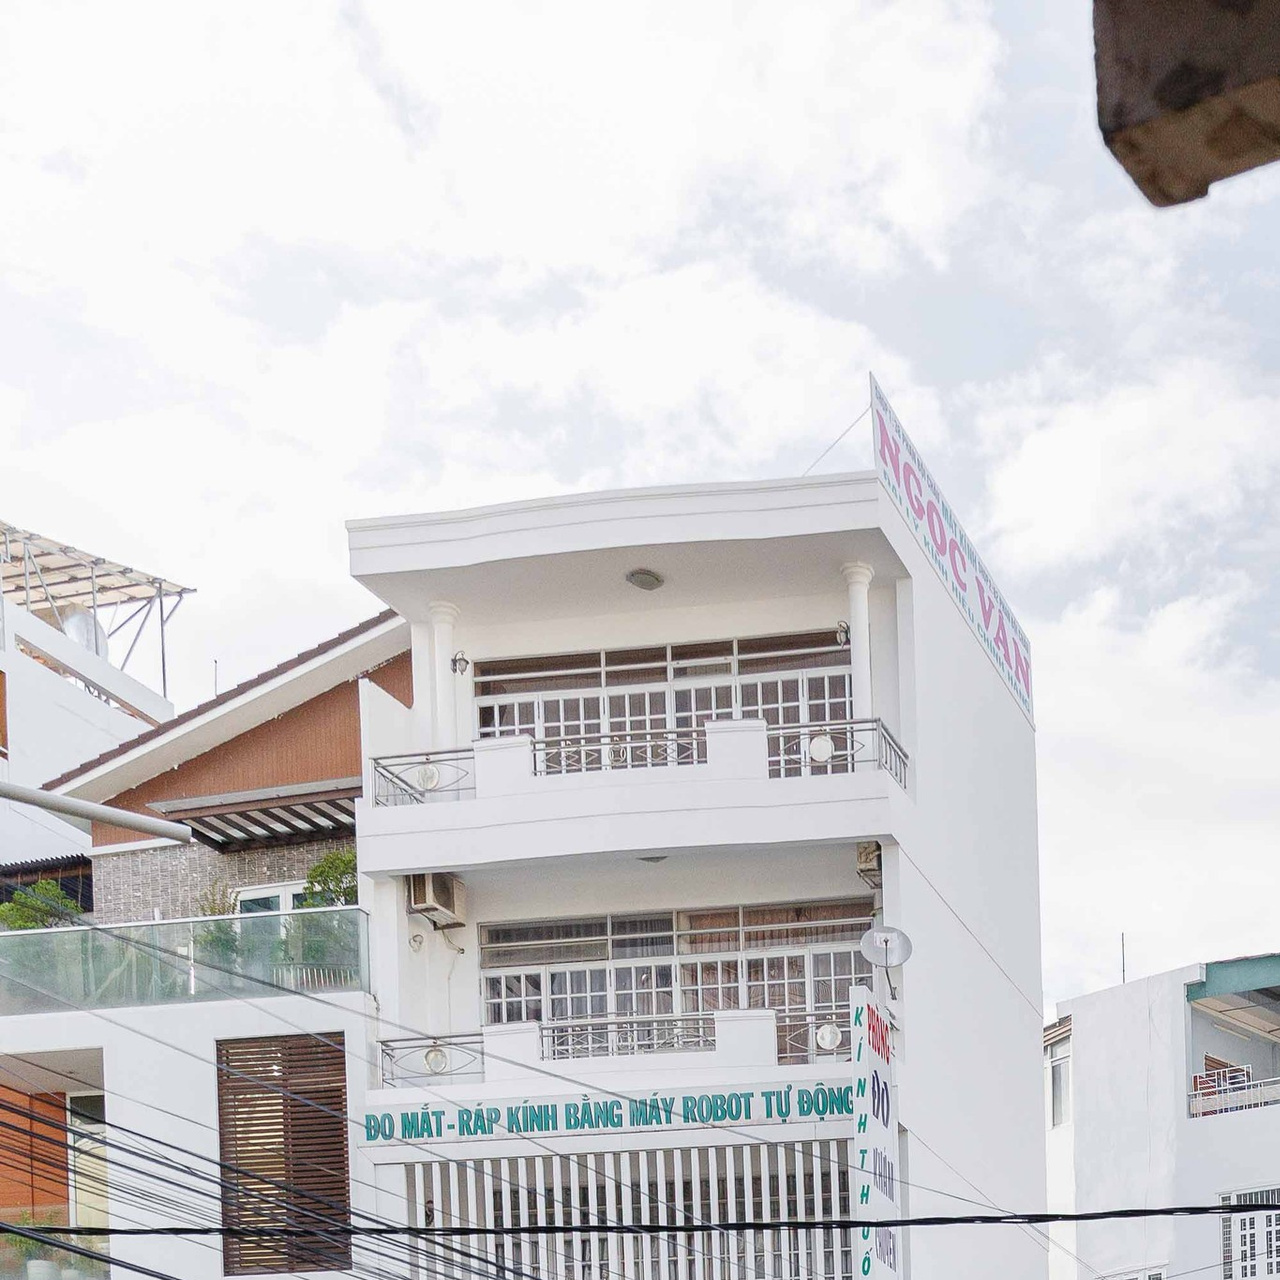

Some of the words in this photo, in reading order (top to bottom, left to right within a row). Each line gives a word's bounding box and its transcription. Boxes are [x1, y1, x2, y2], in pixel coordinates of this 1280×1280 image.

[975, 576, 1030, 700] VÂN
[867, 1003, 890, 1065] PHÒNG
[365, 1113, 395, 1141] ĐO
[401, 1103, 445, 1139] MẮT
[458, 1102, 500, 1136] RÁP
[507, 1099, 558, 1133] KÍNH
[565, 1093, 623, 1131] BẰNG
[629, 1092, 675, 1127] MÁY
[682, 1092, 754, 1123] ROBOT
[761, 1084, 792, 1123] TỰ
[797, 1082, 853, 1121] ĐỘNG
[872, 1070, 890, 1129] ĐO
